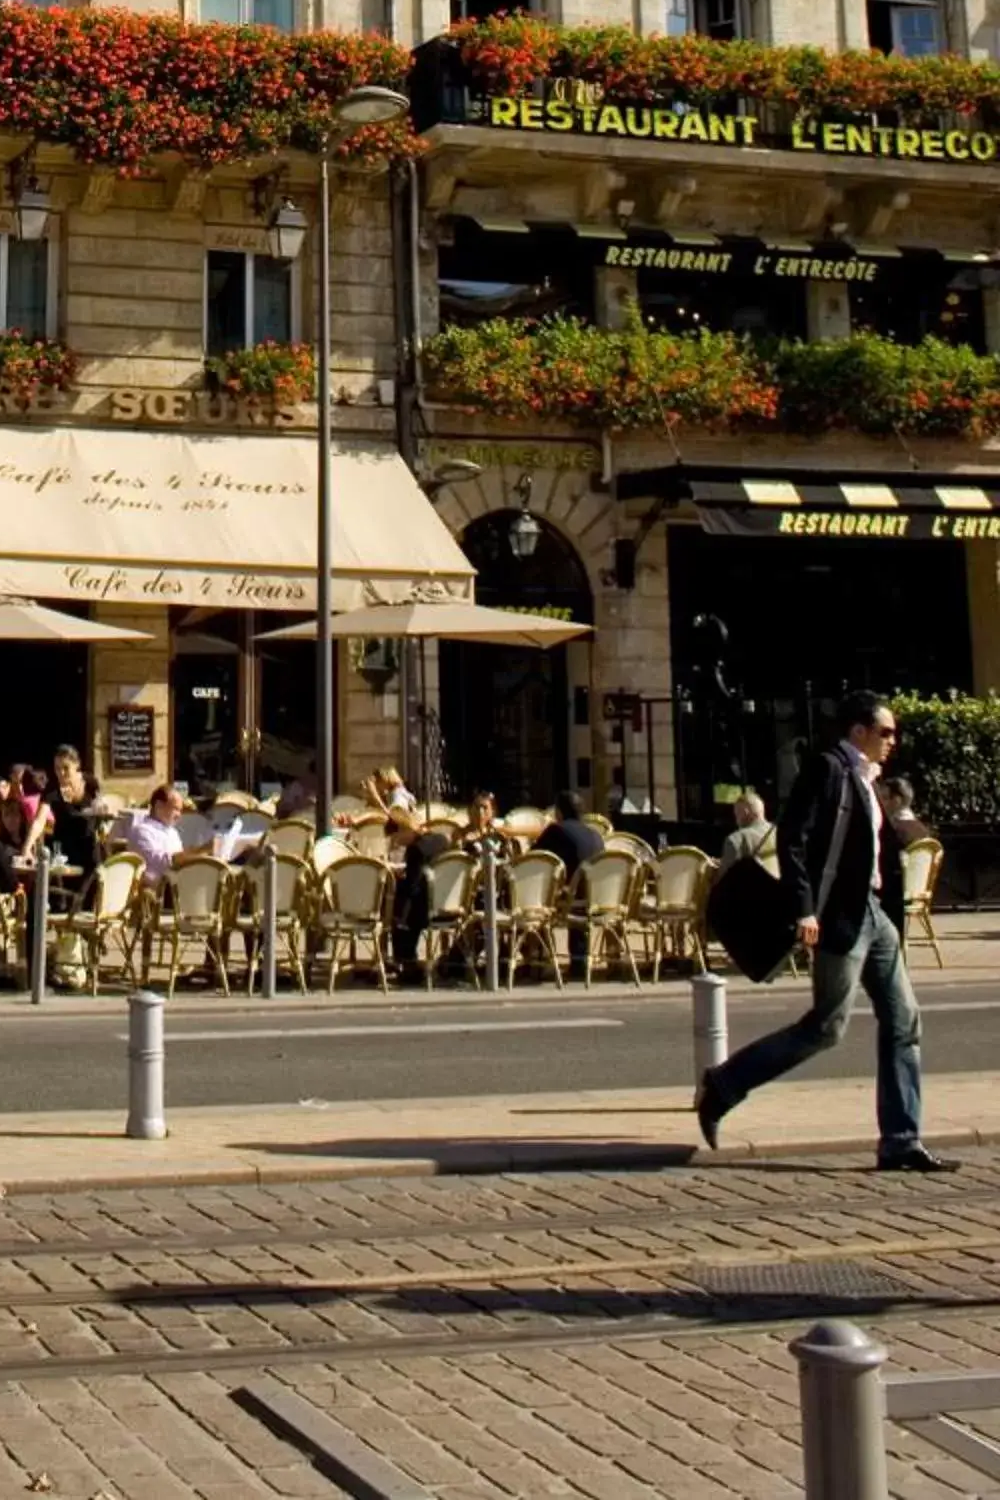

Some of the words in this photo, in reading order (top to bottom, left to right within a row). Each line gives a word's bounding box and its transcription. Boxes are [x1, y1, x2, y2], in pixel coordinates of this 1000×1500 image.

[491, 97, 758, 144] RESTAURANT
[604, 245, 732, 273] RESTAURANT
[91, 469, 146, 490] des
[779, 512, 909, 537] RESTAURANT
[63, 566, 128, 599] Café
[142, 570, 183, 594] des
